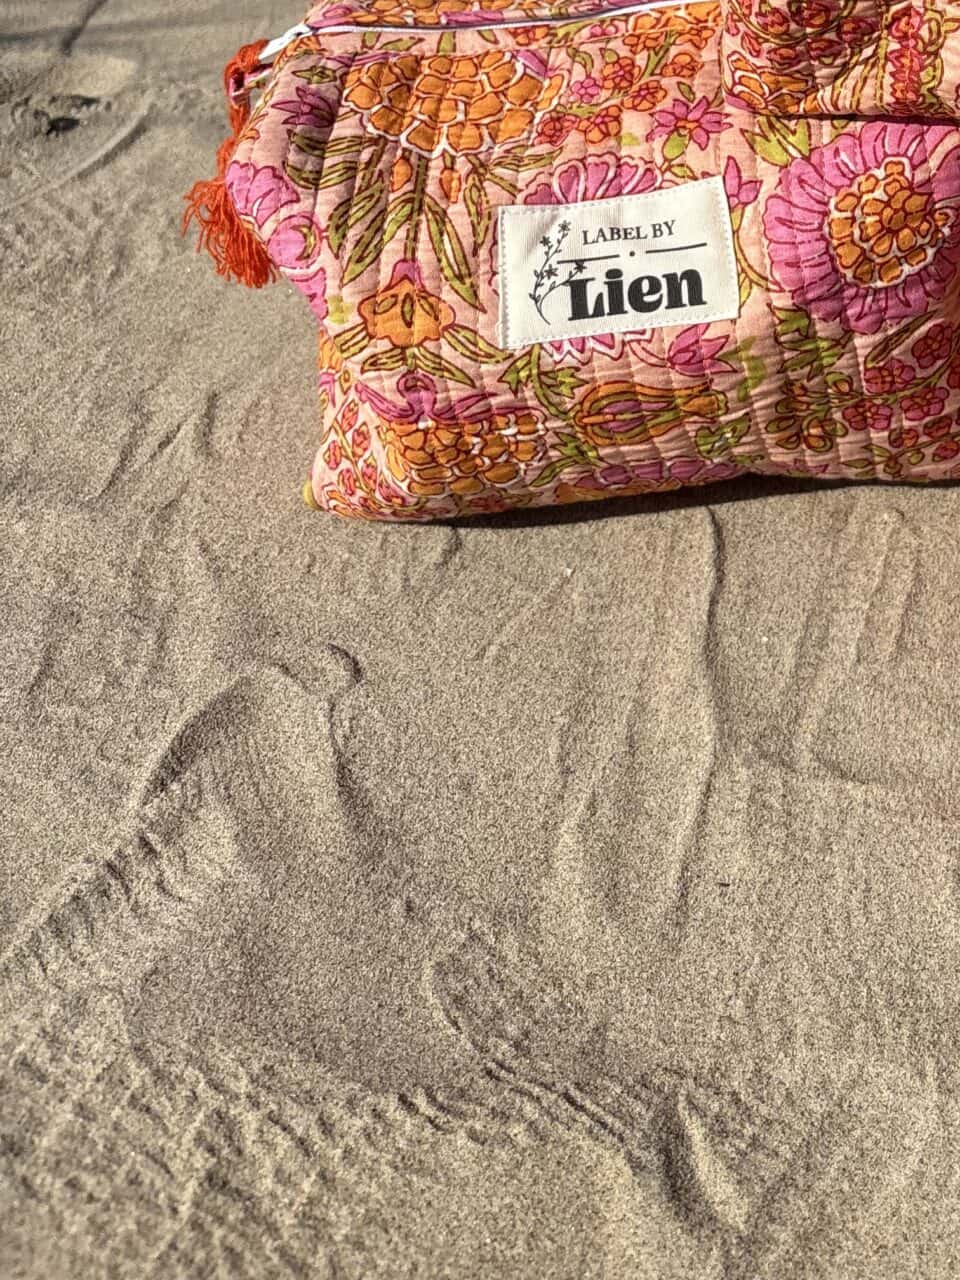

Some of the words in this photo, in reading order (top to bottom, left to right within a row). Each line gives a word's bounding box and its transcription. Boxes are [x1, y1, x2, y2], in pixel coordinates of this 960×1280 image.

[582, 226, 648, 246] LABEL
[651, 219, 677, 239] BY
[567, 268, 707, 321] Lien
